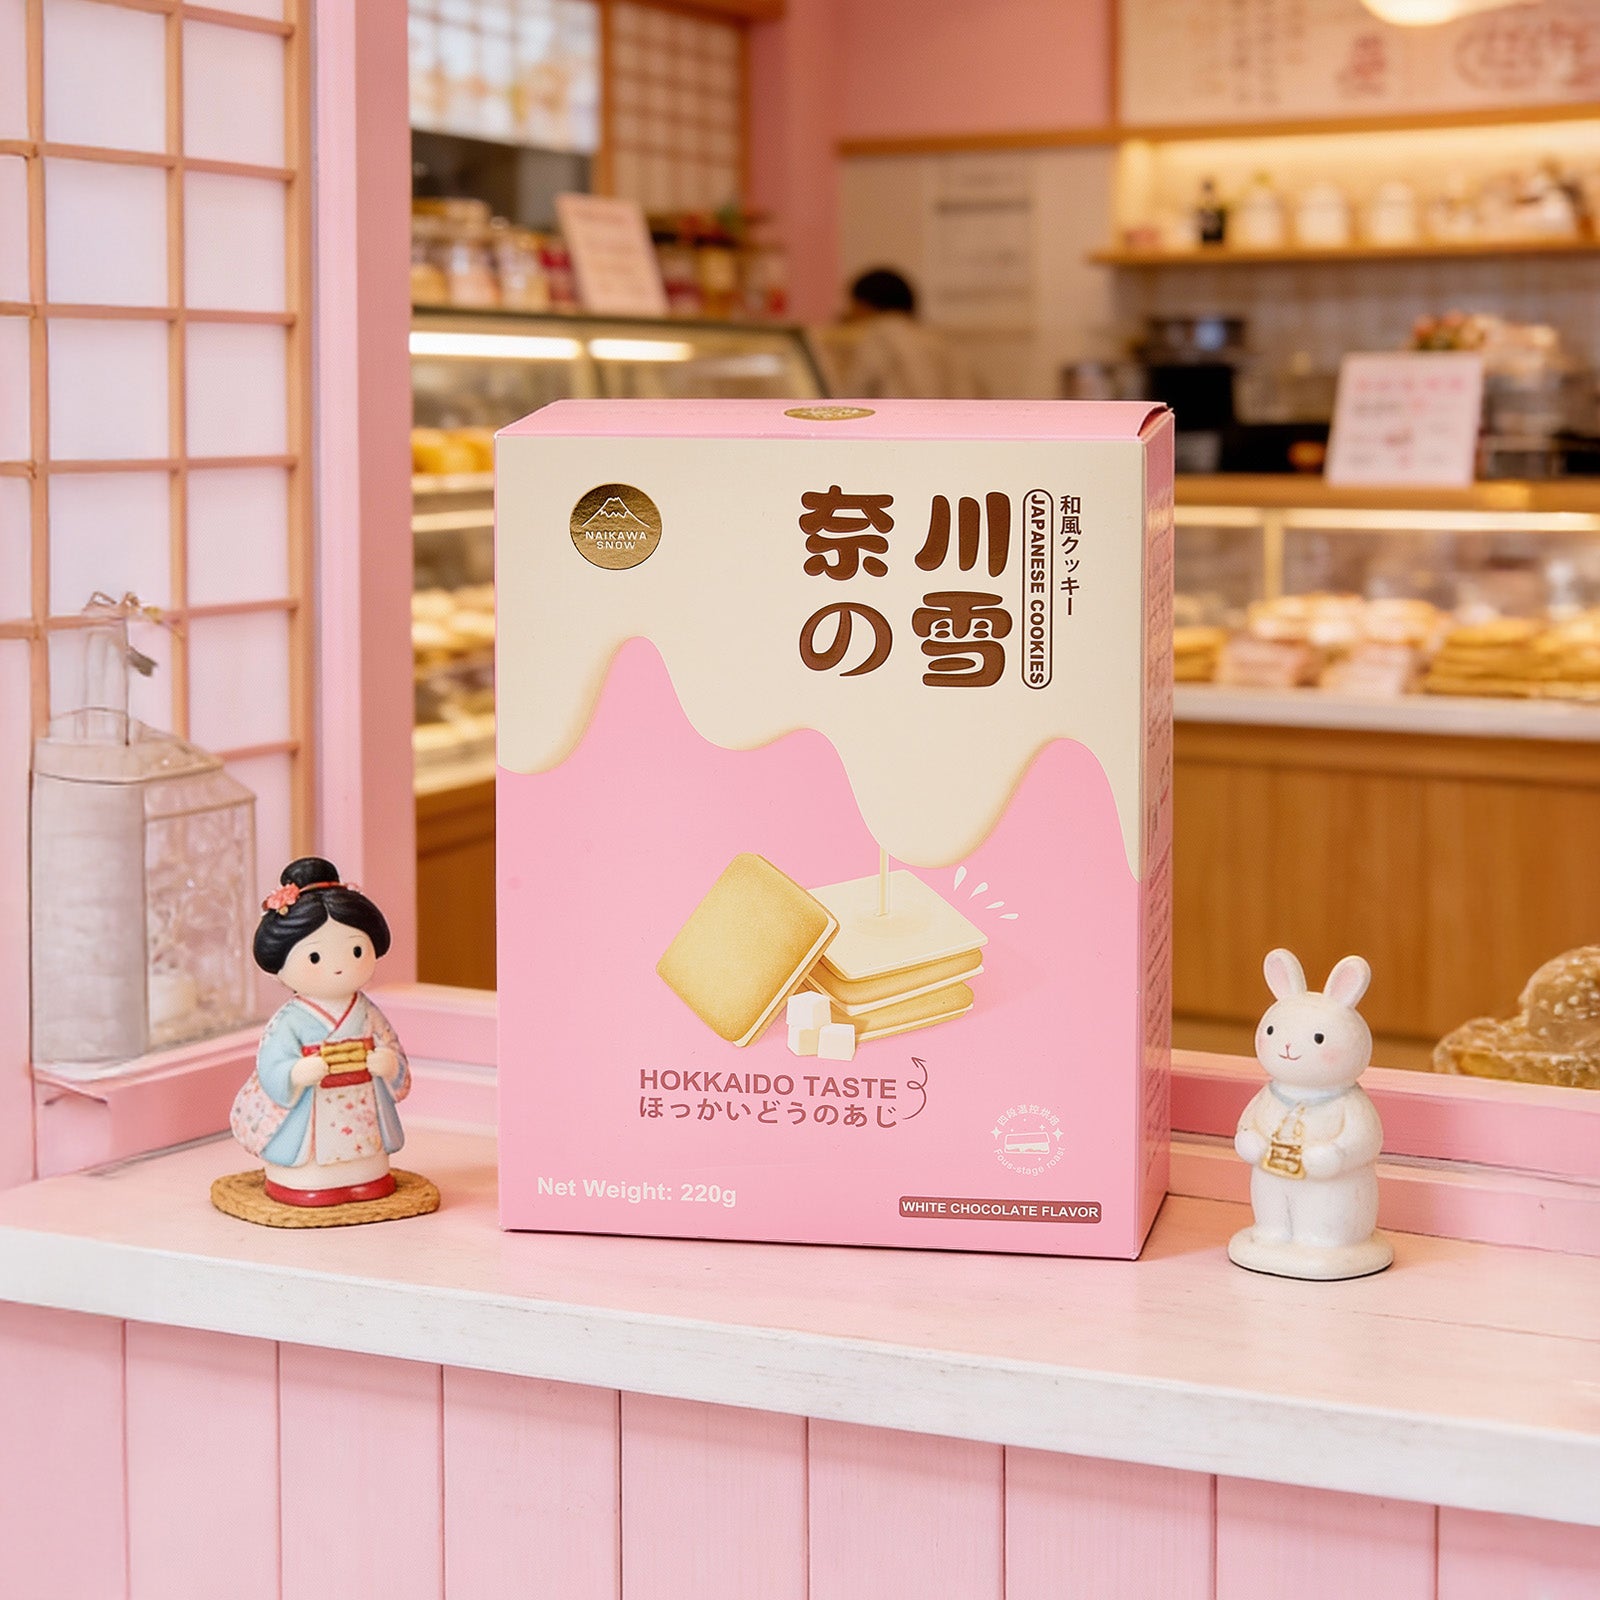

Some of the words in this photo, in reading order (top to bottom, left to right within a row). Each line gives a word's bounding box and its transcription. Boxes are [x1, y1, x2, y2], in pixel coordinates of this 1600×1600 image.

[585, 531, 647, 540] NAIKAWA
[597, 541, 636, 549] SNOW
[1030, 494, 1045, 594] JAPANESE
[1060, 494, 1082, 616] 和風クッキー
[1030, 599, 1045, 684] COOKIES
[640, 1068, 794, 1096] HOKKAIDO
[803, 1075, 897, 1100] TASTE
[639, 1096, 898, 1129] ほっかいどうのあじ
[537, 1177, 576, 1196] Net
[583, 1179, 672, 1204] Weight:
[680, 1183, 737, 1208] 220g
[902, 1201, 947, 1213] WHITE
[950, 1203, 1038, 1217] CHOCOLATE
[1041, 1206, 1099, 1218] FLAVOR
